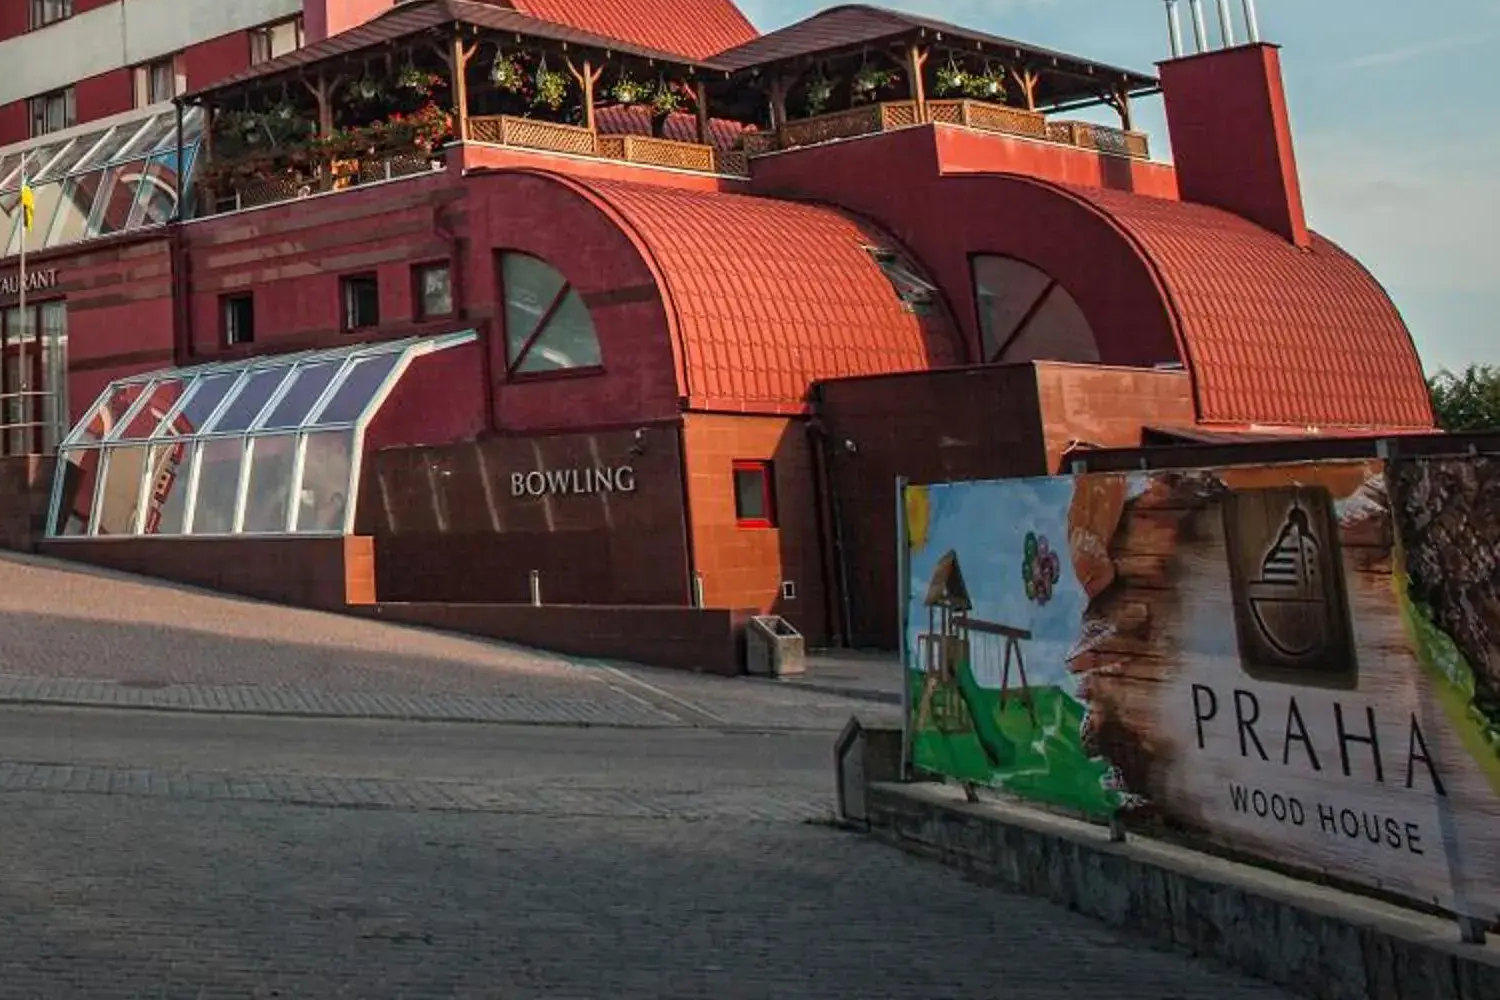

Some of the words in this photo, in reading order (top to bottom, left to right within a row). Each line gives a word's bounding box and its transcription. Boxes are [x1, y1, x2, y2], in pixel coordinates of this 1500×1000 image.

[510, 466, 636, 496] BOWLING
[1191, 683, 1448, 797] PRAHA
[1229, 783, 1304, 826] WOOD
[1318, 803, 1424, 855] HOUSE
